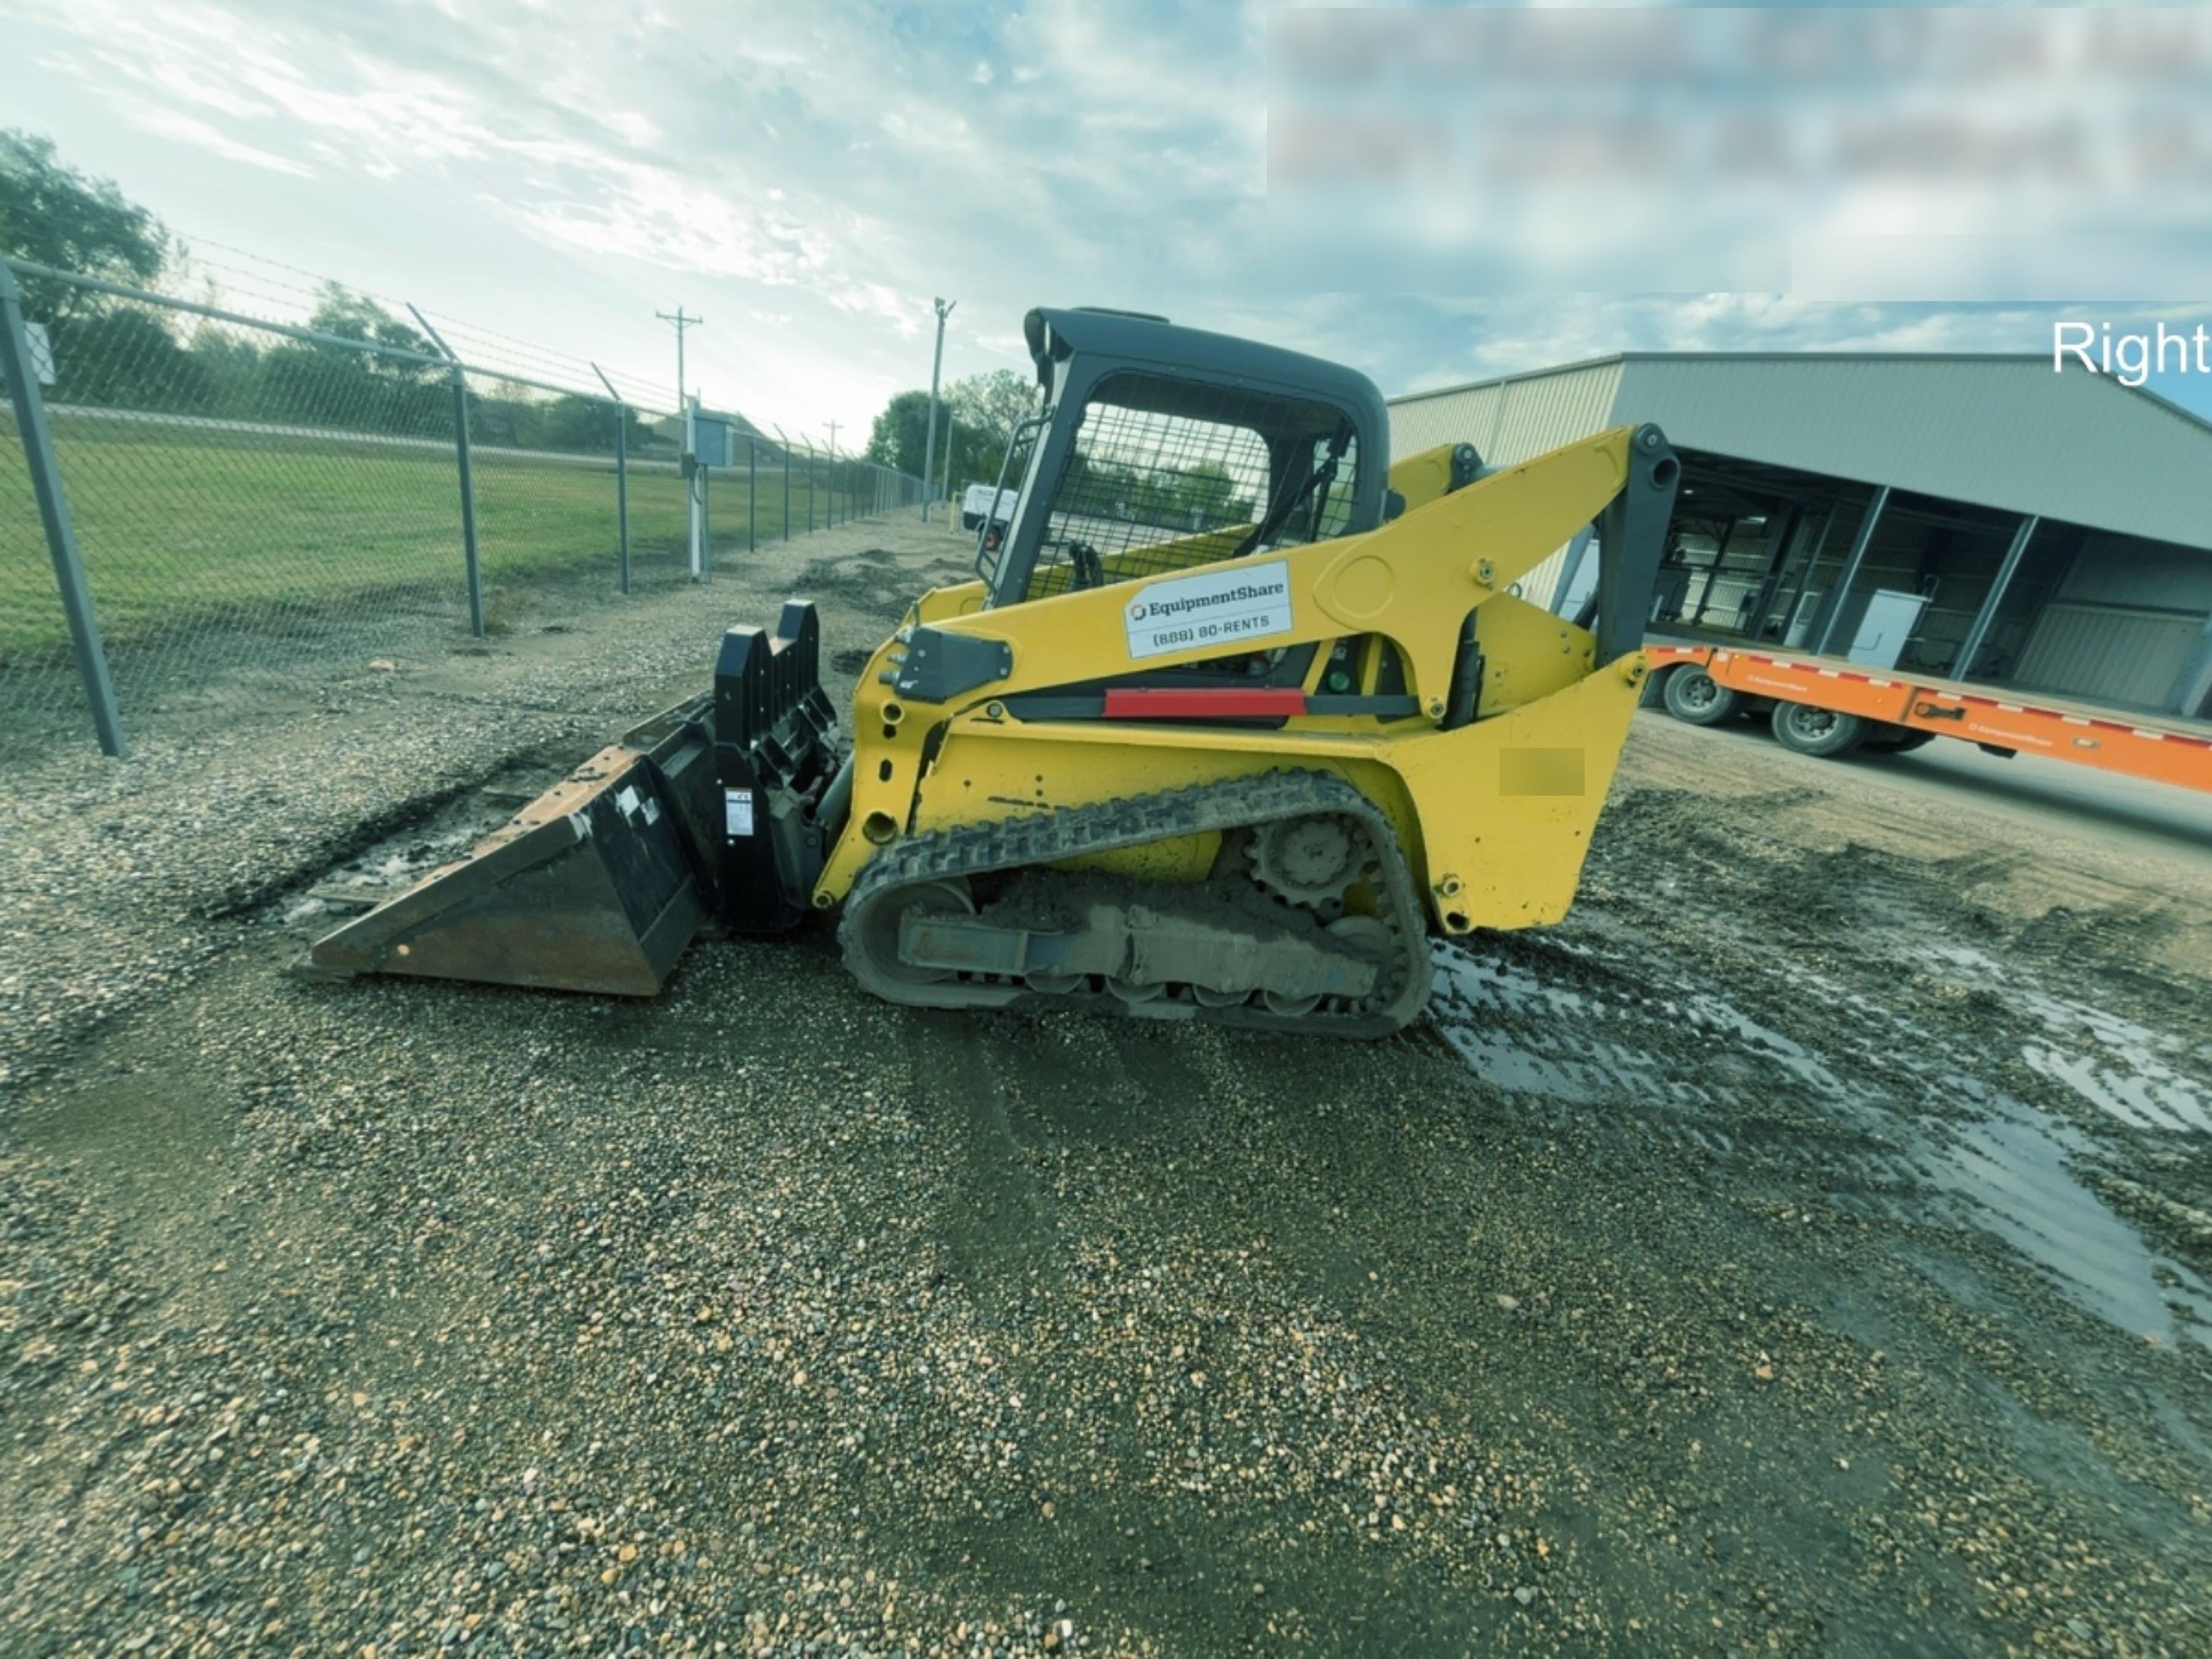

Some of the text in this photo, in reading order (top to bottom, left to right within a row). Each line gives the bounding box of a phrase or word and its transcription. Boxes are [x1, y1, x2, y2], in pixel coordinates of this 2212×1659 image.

[1149, 583, 1284, 617] EquipmentShare
[1153, 615, 1270, 647] (888) 80-RENTS
